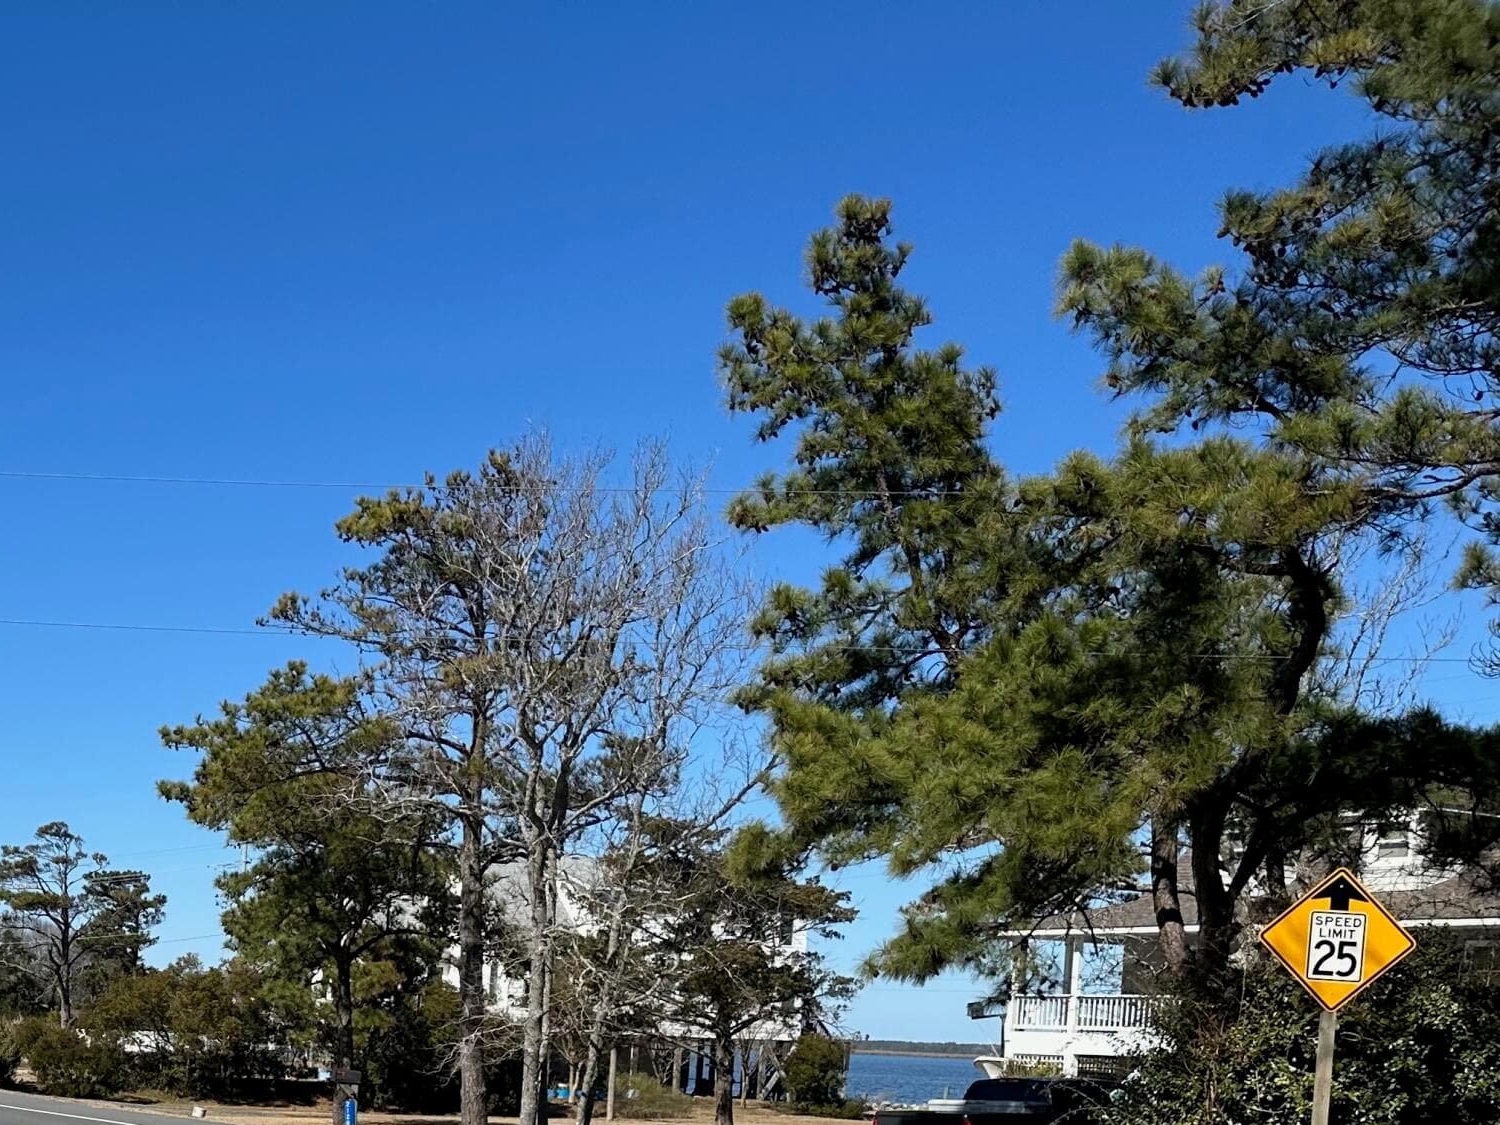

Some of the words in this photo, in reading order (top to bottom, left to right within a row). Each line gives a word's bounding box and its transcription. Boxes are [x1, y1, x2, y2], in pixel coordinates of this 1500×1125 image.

[1315, 916, 1362, 928] SPEED
[1319, 928, 1356, 939] LIMIT
[1312, 940, 1357, 977] 25
